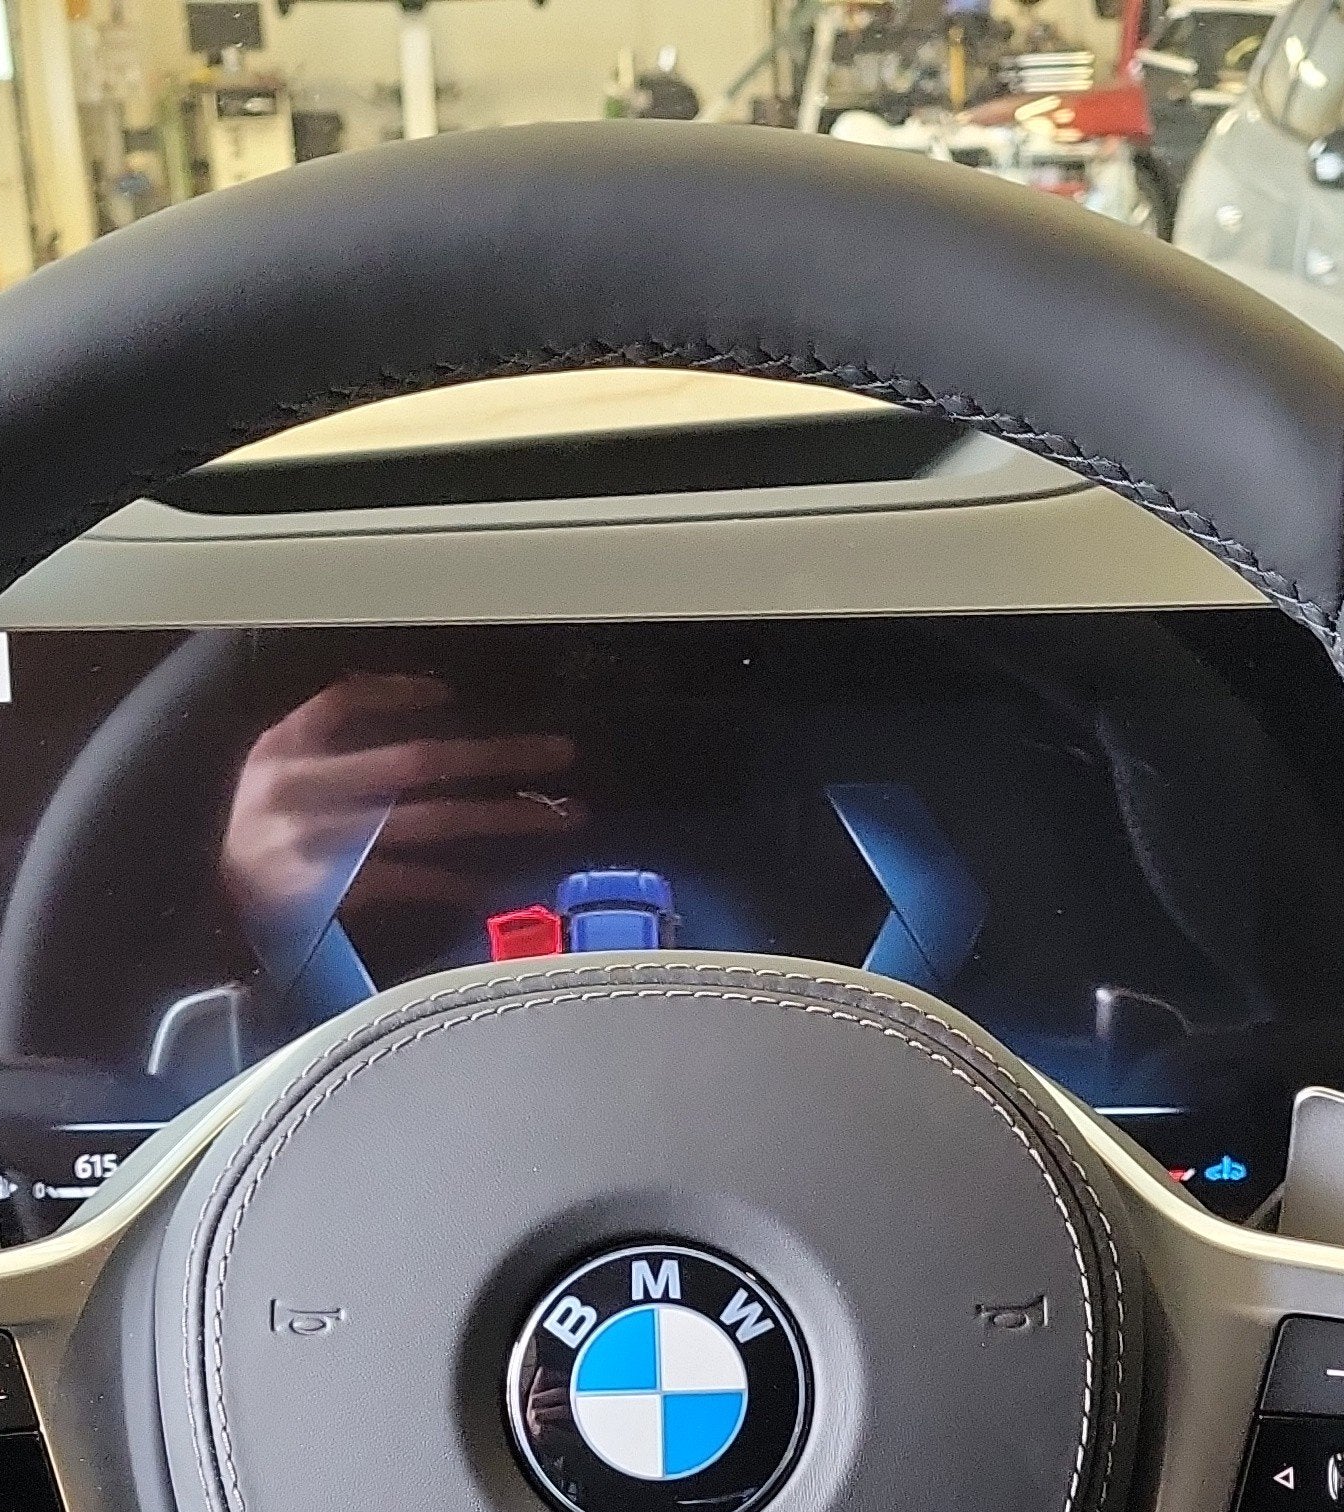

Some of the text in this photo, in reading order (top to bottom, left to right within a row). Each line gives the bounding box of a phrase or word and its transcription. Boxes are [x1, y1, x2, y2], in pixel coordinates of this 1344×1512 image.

[74, 1153, 119, 1179] 615
[32, 1181, 46, 1200] 0
[542, 1259, 776, 1350] BMW
